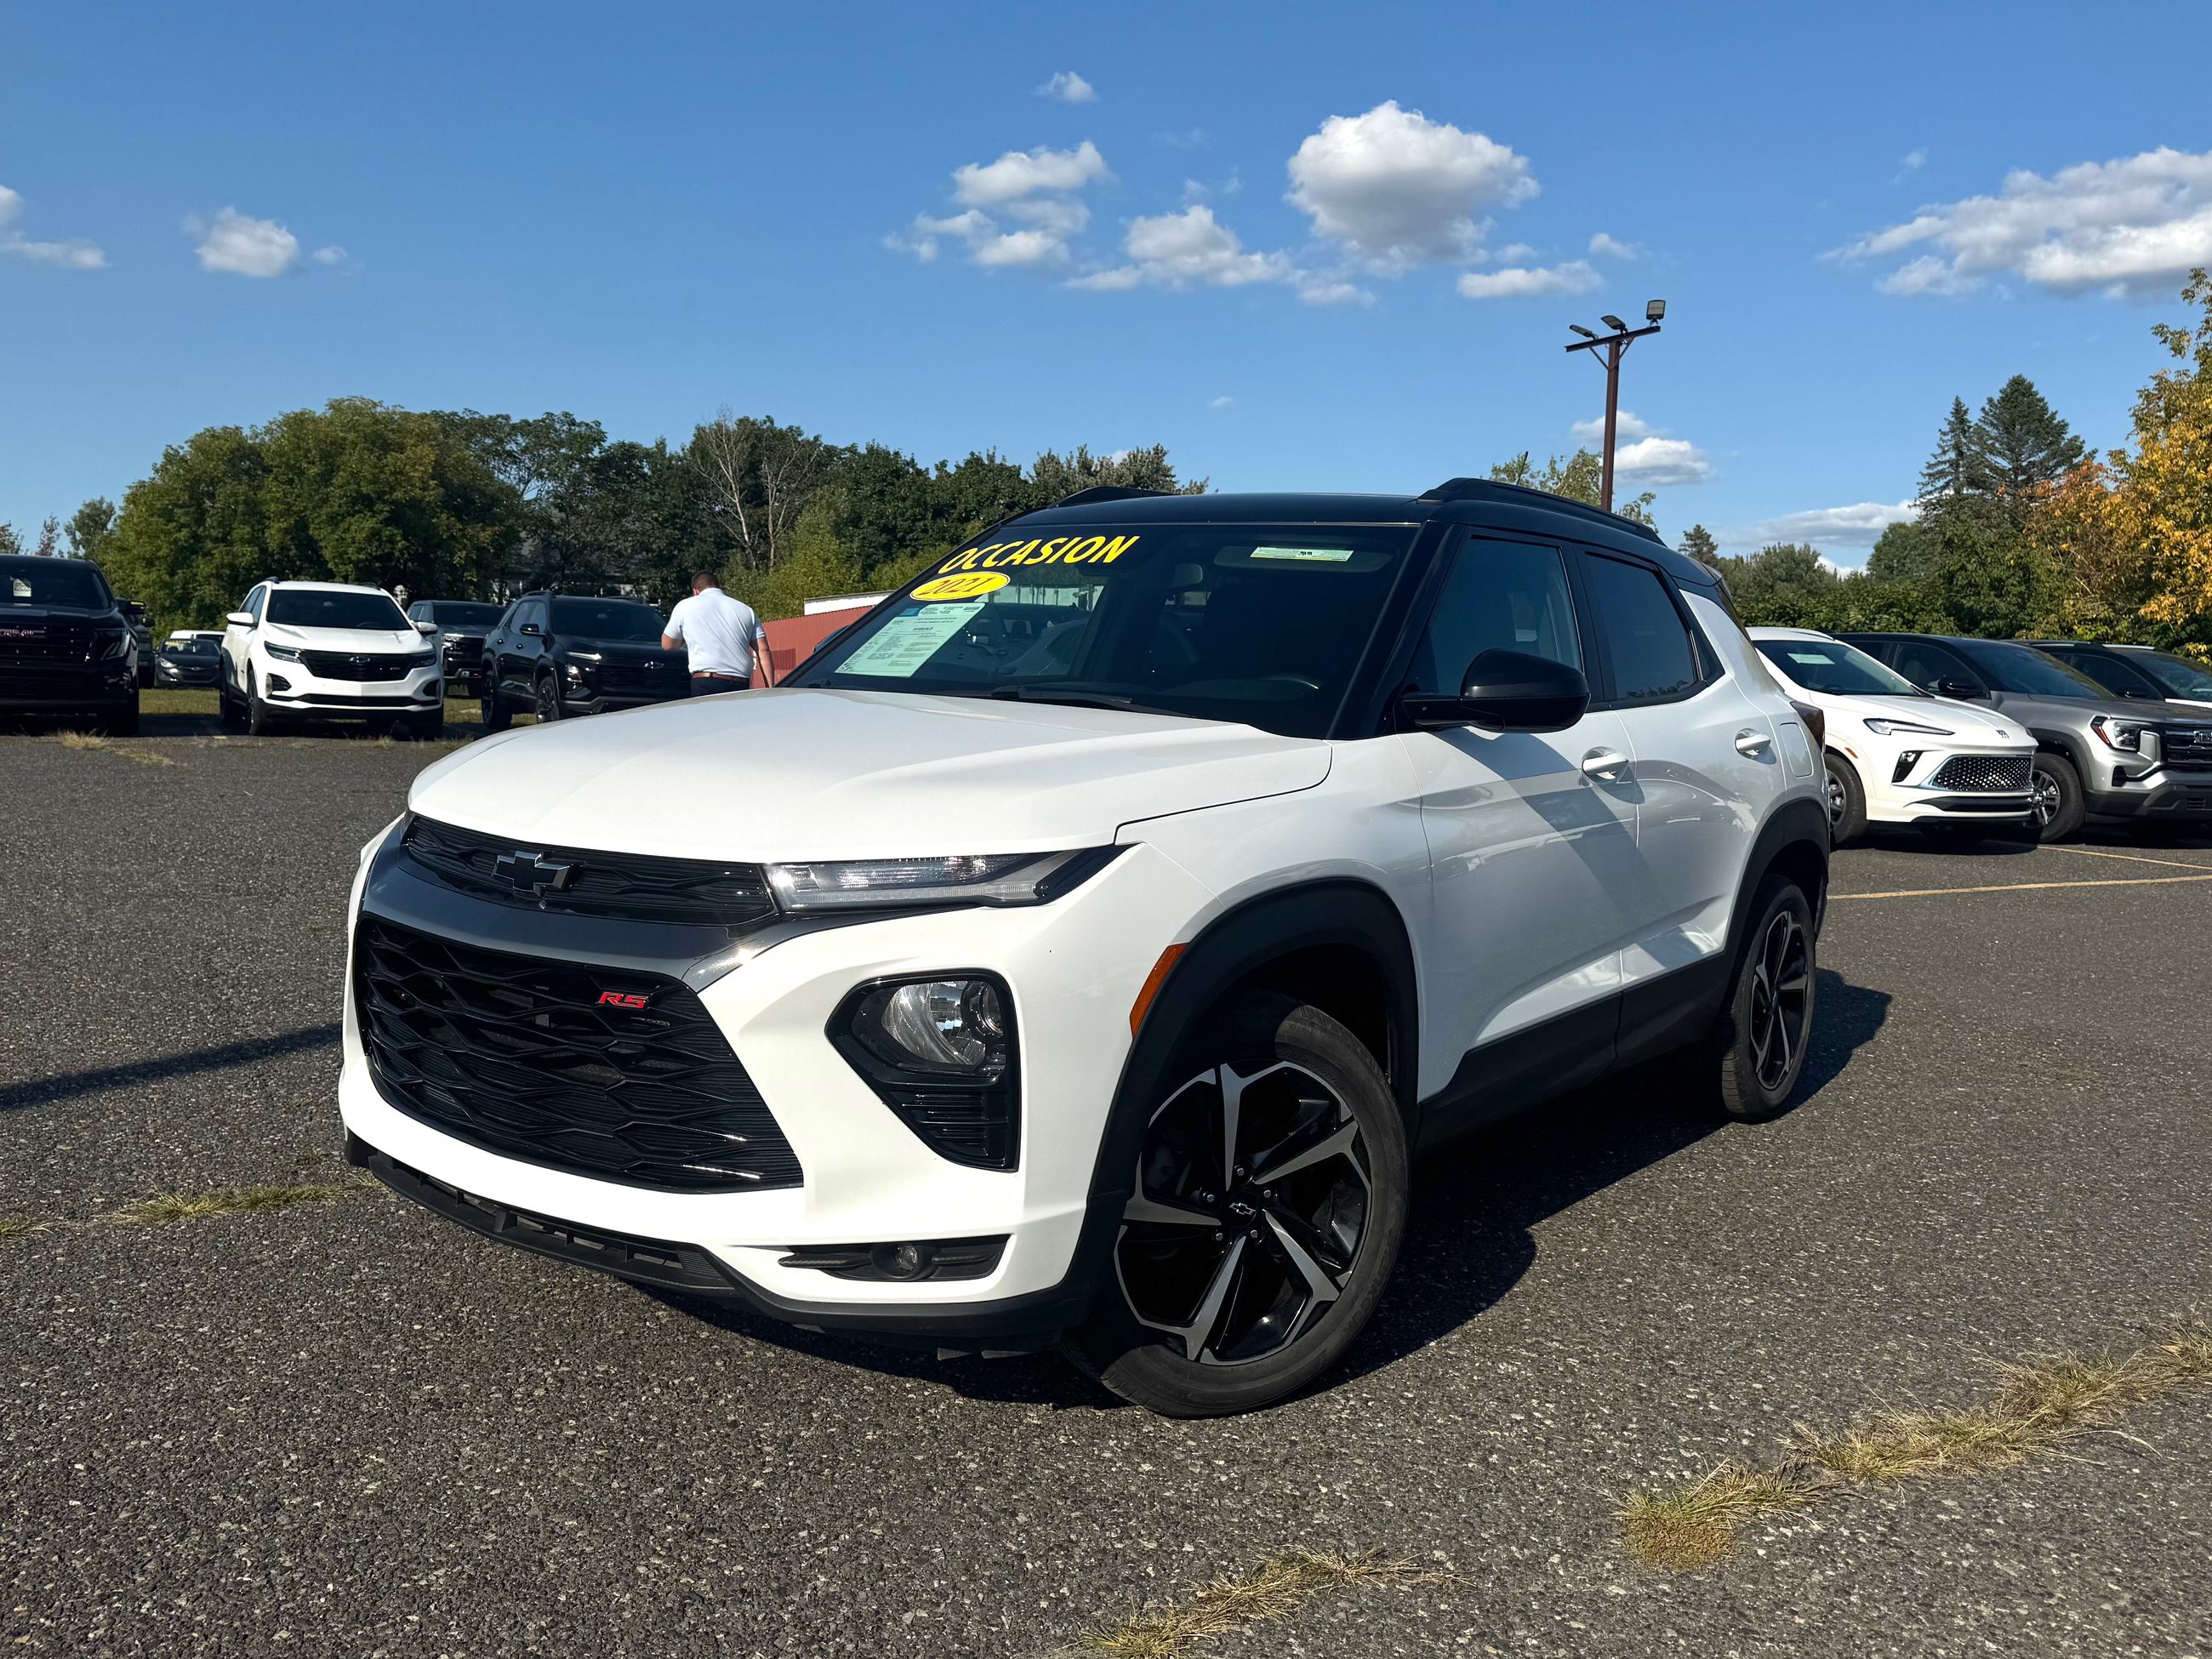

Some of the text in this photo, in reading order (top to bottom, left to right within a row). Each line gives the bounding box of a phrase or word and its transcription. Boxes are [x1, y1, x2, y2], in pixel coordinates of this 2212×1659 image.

[938, 536, 1141, 574] OCCASION
[921, 576, 996, 596] 2021
[598, 992, 649, 1009] RS
